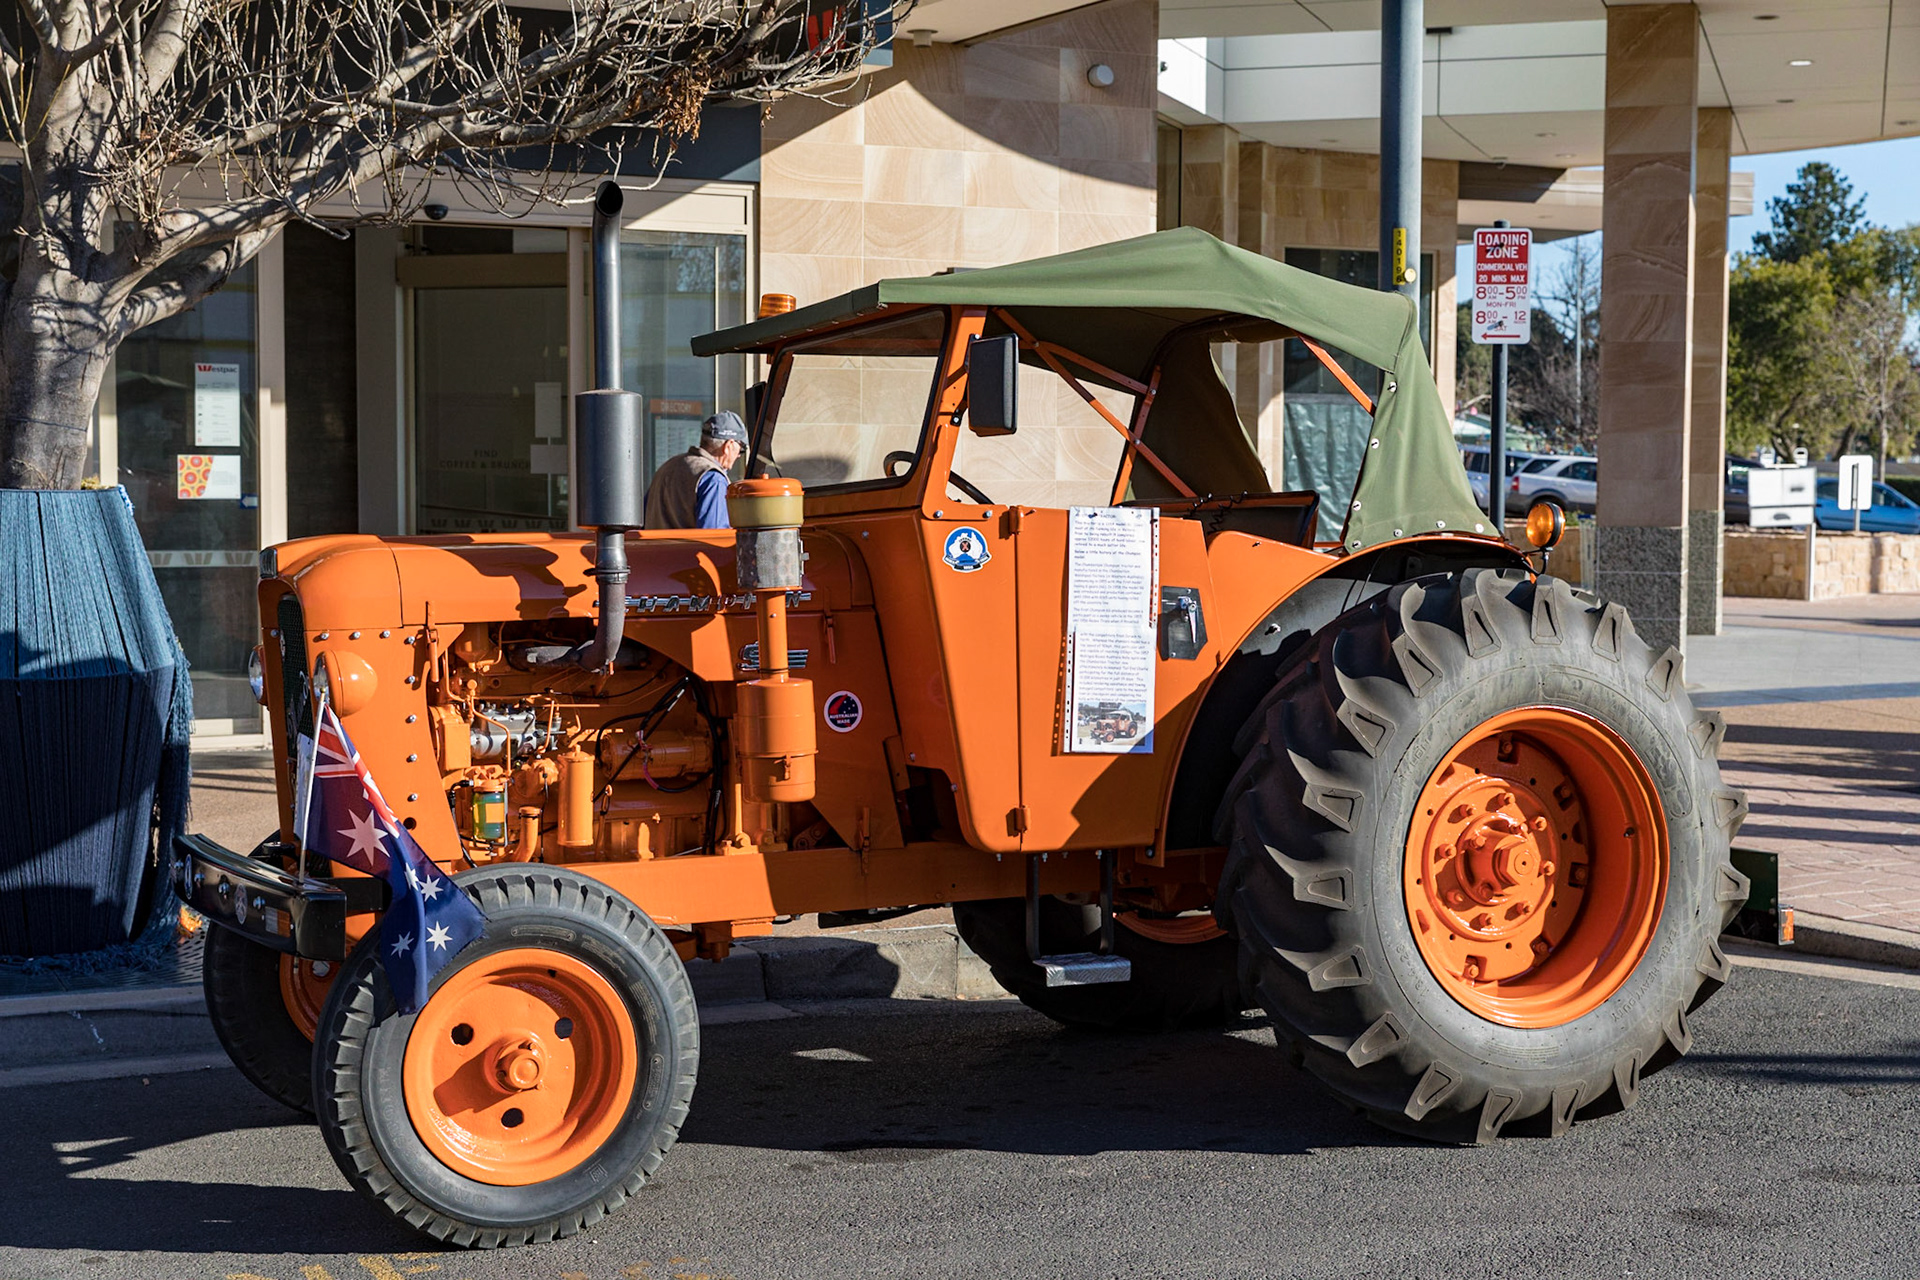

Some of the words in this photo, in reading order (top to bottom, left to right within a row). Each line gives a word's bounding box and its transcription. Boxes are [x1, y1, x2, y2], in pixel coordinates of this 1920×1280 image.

[1479, 233, 1527, 246] LOADING
[1486, 246, 1519, 258] ZONE
[1477, 263, 1514, 271] COMMERCIAL
[1515, 263, 1528, 271] VEH
[1478, 274, 1488, 282] 20
[1491, 274, 1508, 282] MINS
[1510, 274, 1525, 282] MAX
[197, 364, 238, 374] Westpac
[660, 402, 692, 412] DIRECTORY
[625, 591, 802, 613] HAMPIN
[1633, 965, 1660, 1001] HEAVY
[1610, 995, 1637, 1023] DUTY
